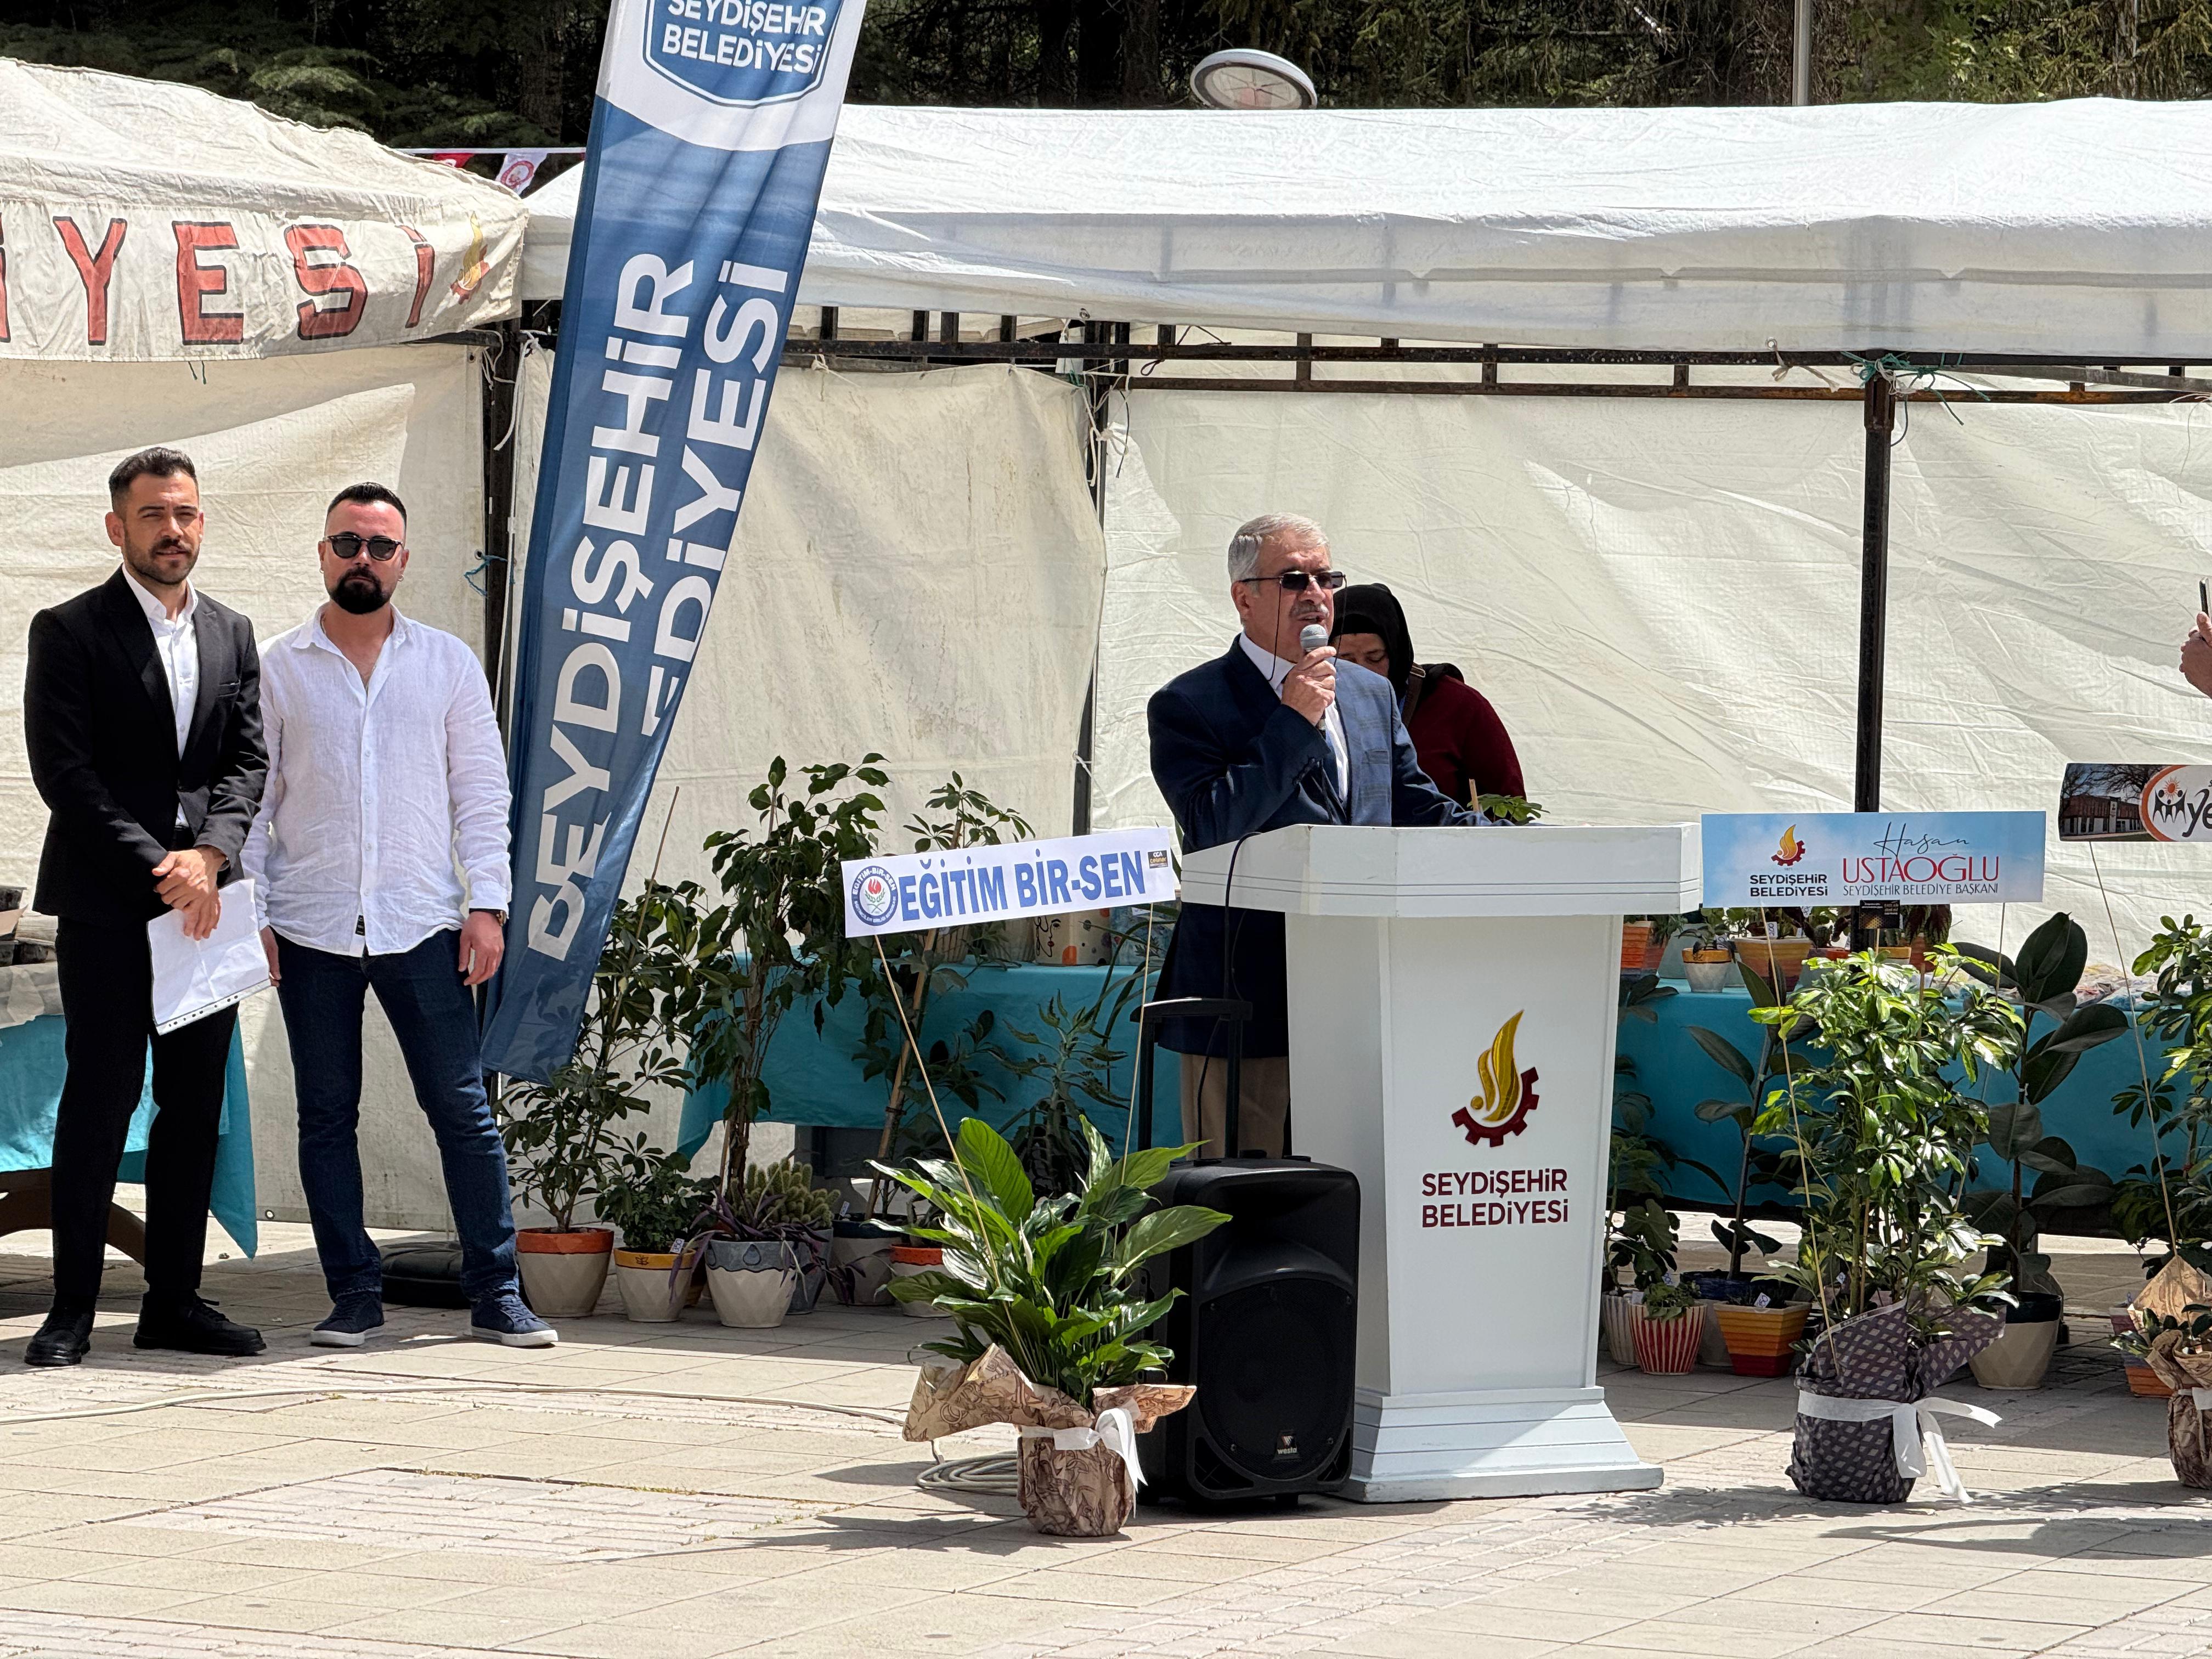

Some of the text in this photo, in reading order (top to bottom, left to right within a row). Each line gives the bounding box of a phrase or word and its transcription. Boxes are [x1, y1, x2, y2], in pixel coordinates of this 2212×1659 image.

[668, 0, 827, 36] SEYDİŞEHR
[662, 23, 822, 75] BELEDİYESİ
[1873, 821, 1970, 857] Hasan
[1750, 874, 1827, 885] SEYDİŞEHİR
[1843, 854, 1999, 883] USTAOĞLU
[898, 855, 1008, 922] EĞİTİM
[1014, 848, 1146, 908] BİR-SEN
[1750, 886, 1828, 897] BELEDİYESİ
[1843, 883, 1998, 897] SEYDİŞEHİR BELEDİYE BAŞKANI
[1421, 1168, 1567, 1198] SEYDİŞEHİR
[1421, 1199, 1568, 1228] BELEDİYESİ
